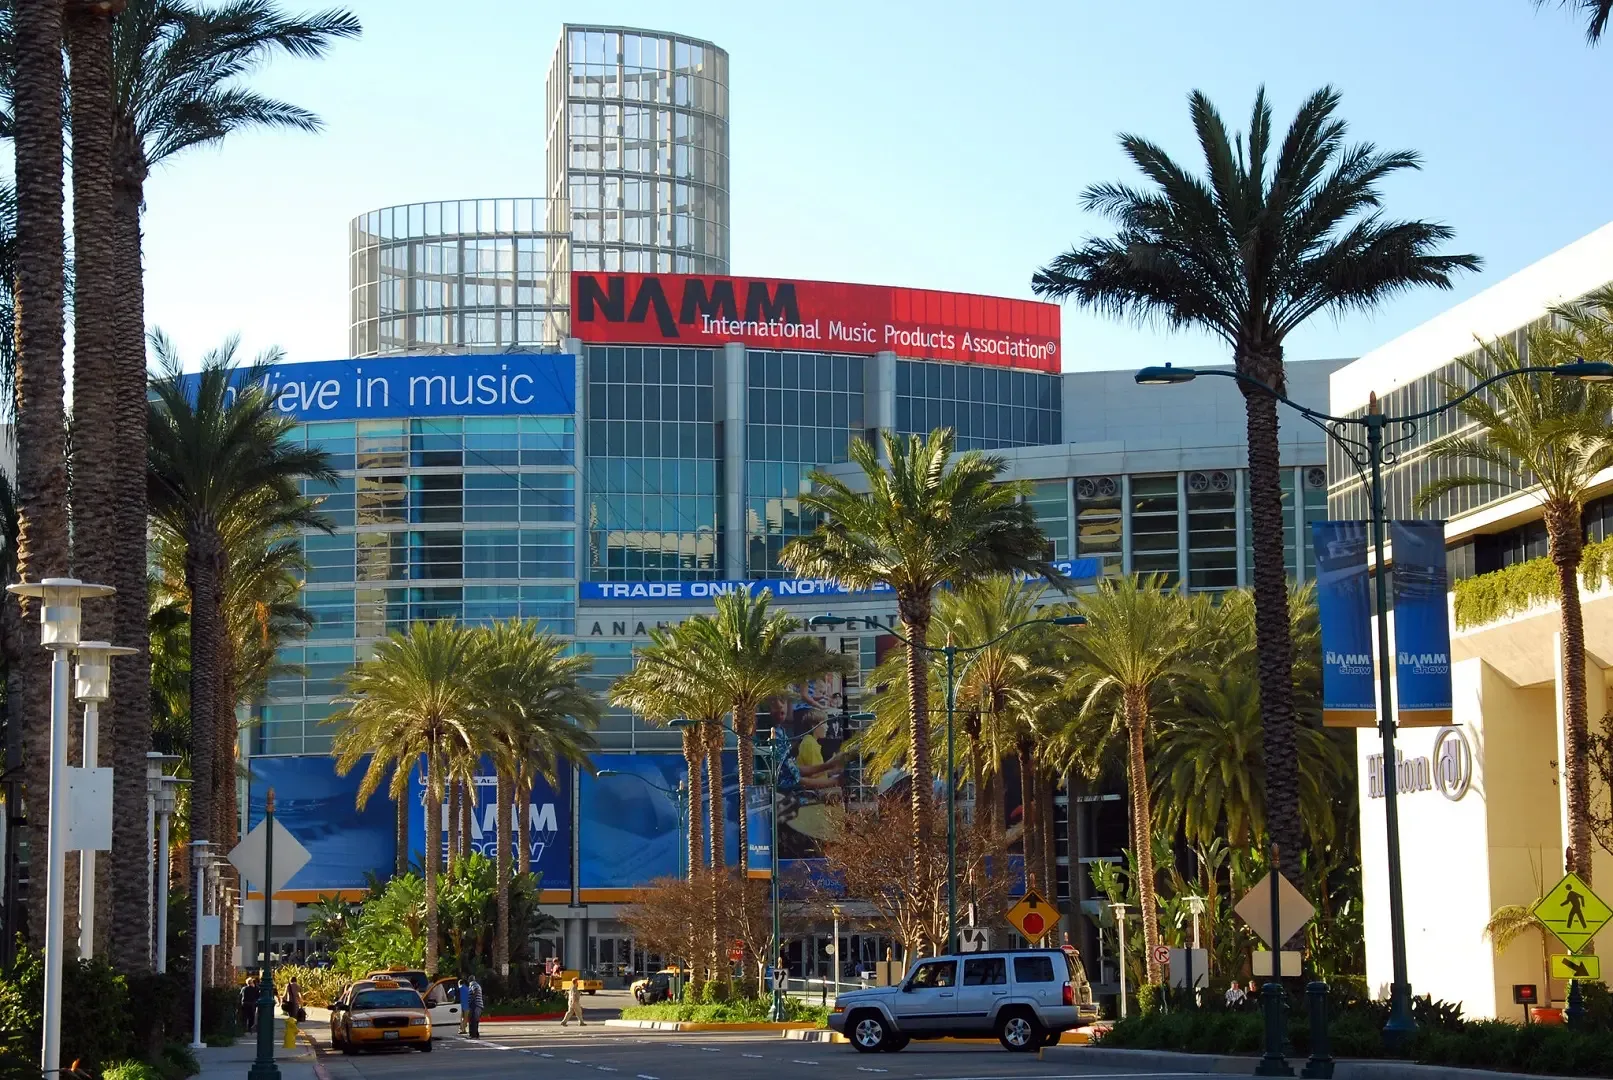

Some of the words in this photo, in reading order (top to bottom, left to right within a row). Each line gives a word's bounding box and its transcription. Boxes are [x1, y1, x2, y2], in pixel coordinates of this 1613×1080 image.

[577, 275, 801, 338] NAMM
[701, 314, 820, 340] International
[828, 321, 876, 344] Music
[884, 326, 956, 351] Products
[355, 367, 388, 408] in
[409, 363, 535, 407] music
[598, 583, 682, 597] TRADE
[690, 581, 755, 597] ONLY
[779, 579, 826, 595] NOT
[1326, 653, 1370, 668] NAMM
[1398, 653, 1447, 668] NAMM
[1339, 664, 1371, 675] show
[1412, 664, 1448, 675] show
